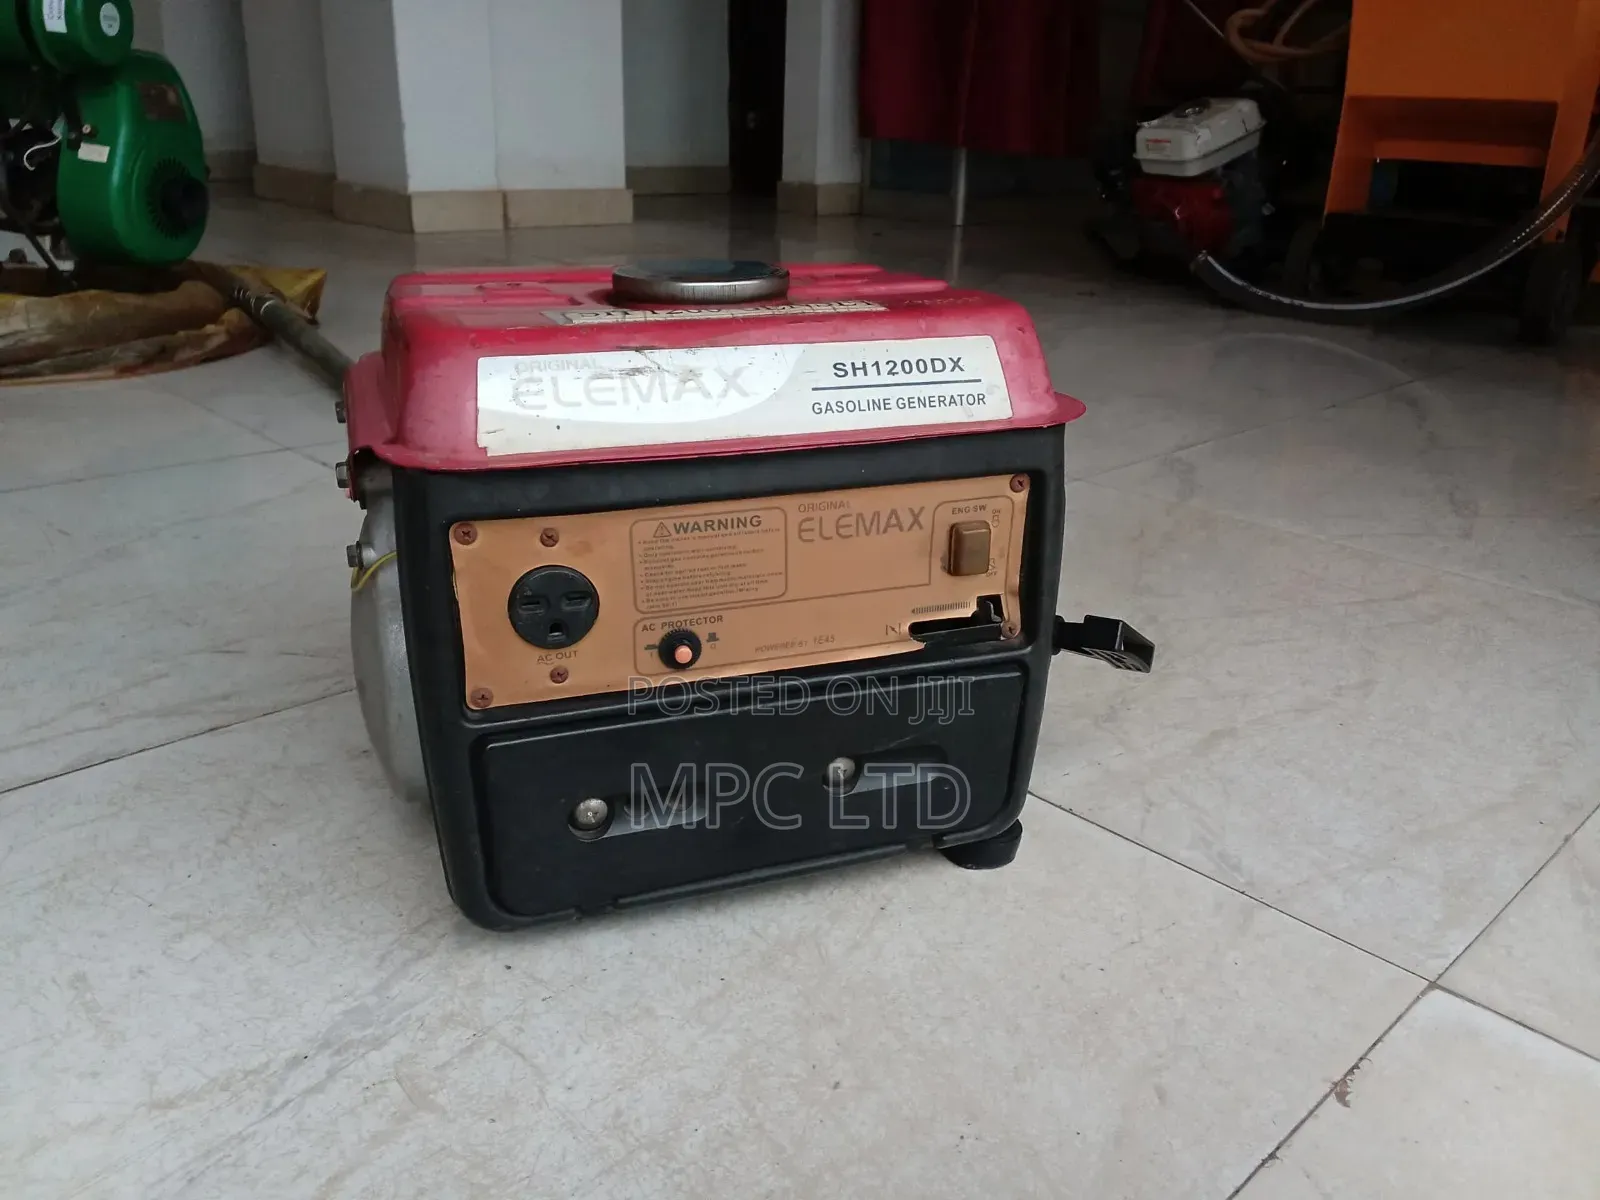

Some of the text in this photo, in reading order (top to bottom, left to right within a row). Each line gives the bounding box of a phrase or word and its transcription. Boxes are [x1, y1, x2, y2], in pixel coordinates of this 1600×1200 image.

[514, 357, 599, 374] ORIGINAL
[832, 356, 965, 378] SH1200DX
[512, 365, 750, 411] ELEMAX
[811, 393, 987, 415] GASOLINE GENERATOR
[798, 500, 851, 513] ORIGINAL
[951, 504, 987, 515] ENG SW
[673, 514, 763, 535] WARNING
[797, 505, 926, 543] ELEMAX
[641, 614, 724, 632] AC PROTECTOR
[537, 650, 579, 662] AC OUT
